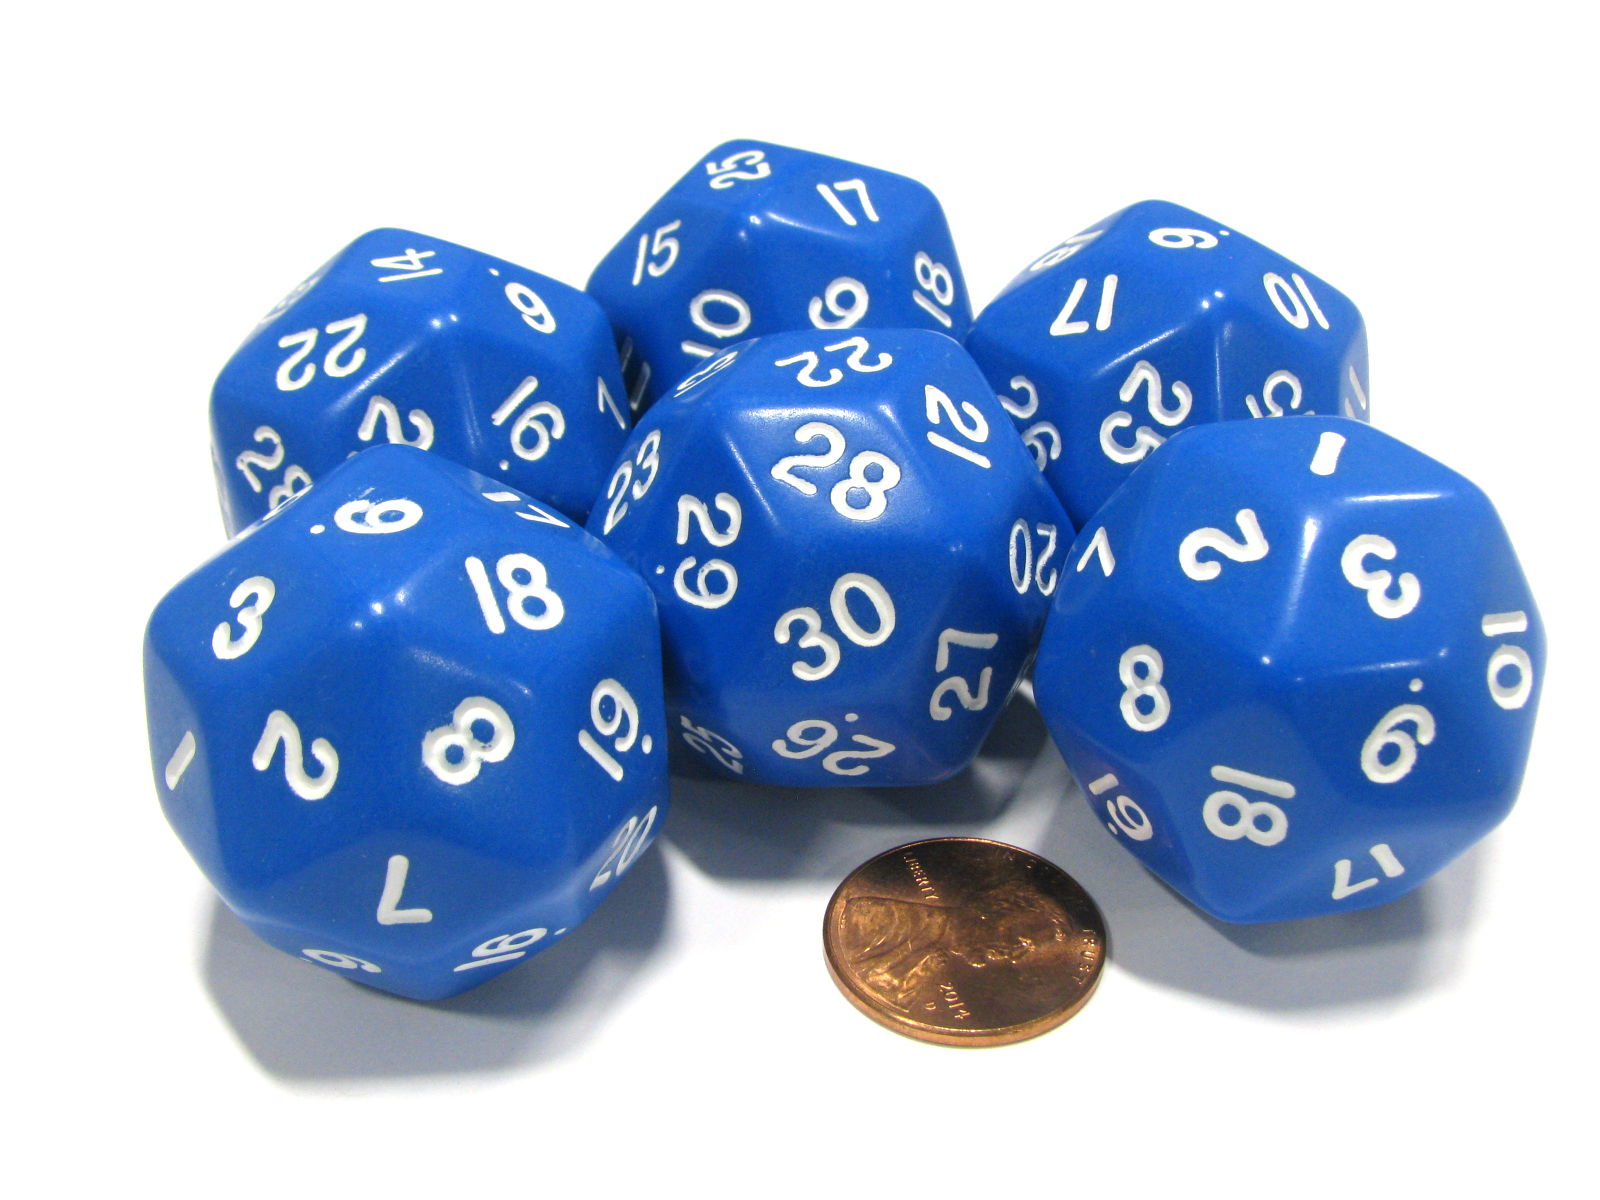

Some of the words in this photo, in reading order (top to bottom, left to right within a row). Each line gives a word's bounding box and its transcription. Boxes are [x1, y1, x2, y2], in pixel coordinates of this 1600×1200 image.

[706, 149, 771, 189] 25
[815, 178, 880, 226] 17
[369, 247, 444, 283] 14
[632, 219, 682, 286] 15
[912, 251, 955, 328] 18
[1048, 273, 1119, 337] 17
[1262, 271, 1331, 331] 10
[275, 313, 368, 392] 22
[773, 335, 894, 388] 22
[924, 384, 992, 469] 21
[1099, 359, 1193, 465] 25
[603, 429, 661, 536] 23
[771, 421, 902, 524] 28
[1309, 431, 1348, 477] 1
[1008, 517, 1058, 597] 20
[1178, 508, 1270, 582] 2
[1340, 533, 1422, 620] 3
[211, 575, 276, 661] 3
[464, 552, 566, 635] 18
[773, 572, 896, 682] 30
[929, 628, 998, 721] 27
[1118, 644, 1171, 733] 8
[1480, 609, 1535, 711] 10
[164, 729, 198, 792] 1
[251, 709, 340, 801] 2
[421, 696, 516, 787] 8
[1202, 764, 1296, 847] 18
[589, 805, 658, 892] 20
[1331, 842, 1406, 901] 17
[376, 854, 433, 926] 7
[939, 981, 971, 1020] 2014
